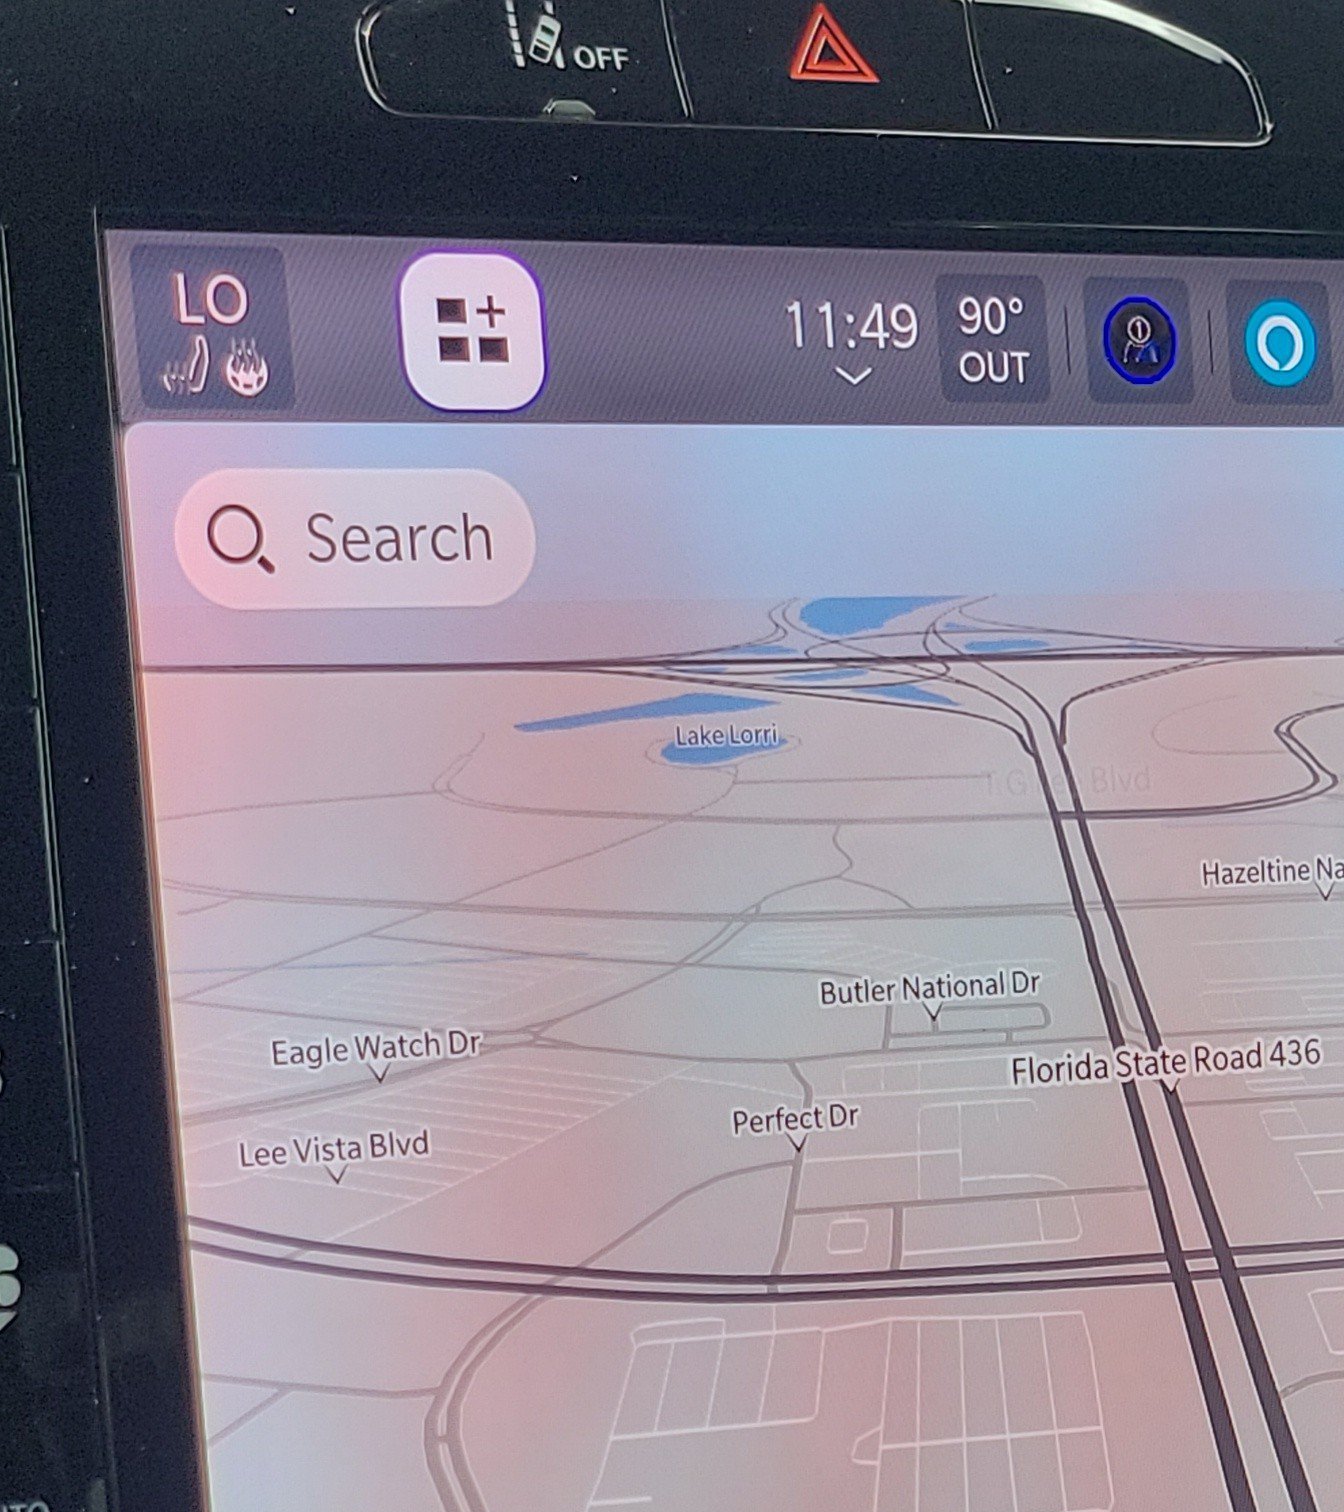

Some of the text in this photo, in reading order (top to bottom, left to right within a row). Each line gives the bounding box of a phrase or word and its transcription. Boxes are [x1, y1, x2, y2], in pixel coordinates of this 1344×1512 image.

[573, 46, 630, 71] OFF
[174, 272, 249, 327] LO
[958, 296, 1025, 336] 90°
[787, 301, 920, 350] 11:49
[959, 351, 1030, 384] OUT
[306, 512, 494, 563] Search
[676, 723, 779, 747] Lake Lorri
[1202, 857, 1310, 886] Hazeltine
[820, 970, 1042, 1006] Butler National Dr
[271, 1030, 482, 1072] Eagle Watch Dr
[1012, 1038, 1322, 1086] Florida State Road 436
[733, 1103, 859, 1135] Perfect Dr
[239, 1130, 430, 1167] Lee Vista Blvd
